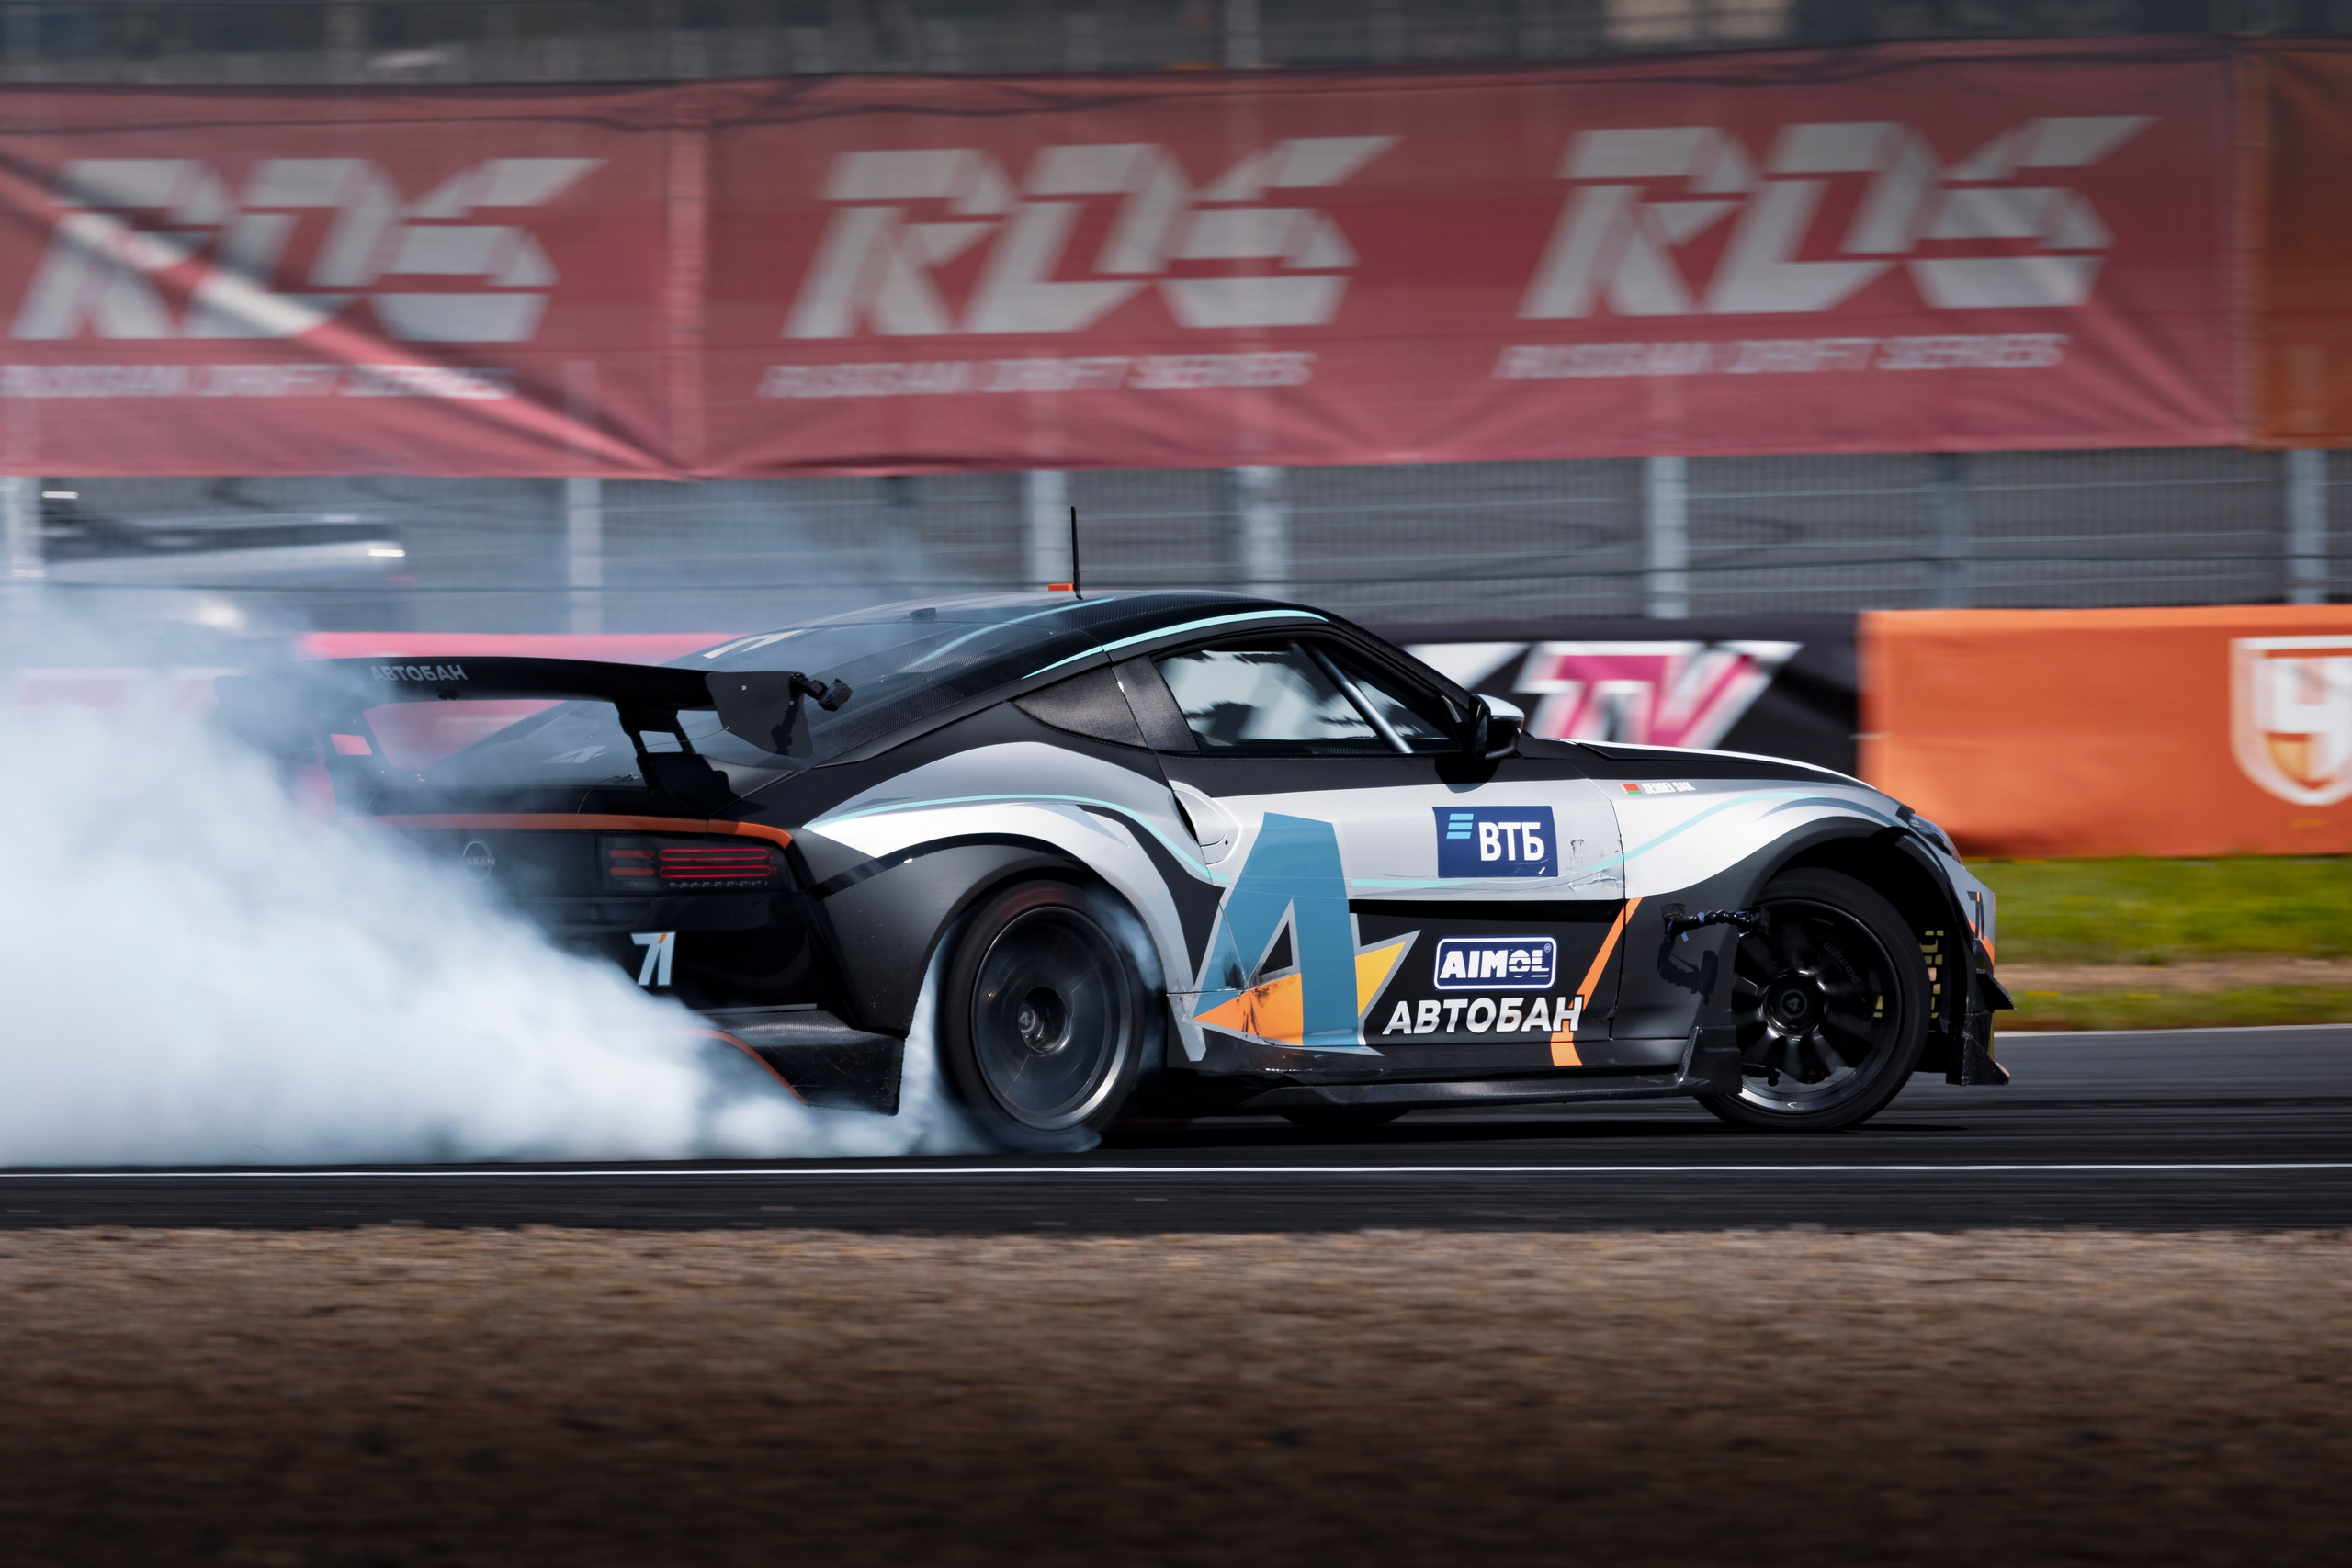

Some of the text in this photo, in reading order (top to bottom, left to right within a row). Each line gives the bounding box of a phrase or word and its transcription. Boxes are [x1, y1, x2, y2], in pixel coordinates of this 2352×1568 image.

[780, 134, 1406, 339] RDS
[1515, 115, 2165, 320] RDS
[7, 158, 610, 342] RDS
[370, 665, 469, 681] АВТОБАН
[1478, 821, 1545, 862] ВТБ
[630, 931, 676, 986] 71
[1382, 996, 1585, 1036] АВТОБАН
